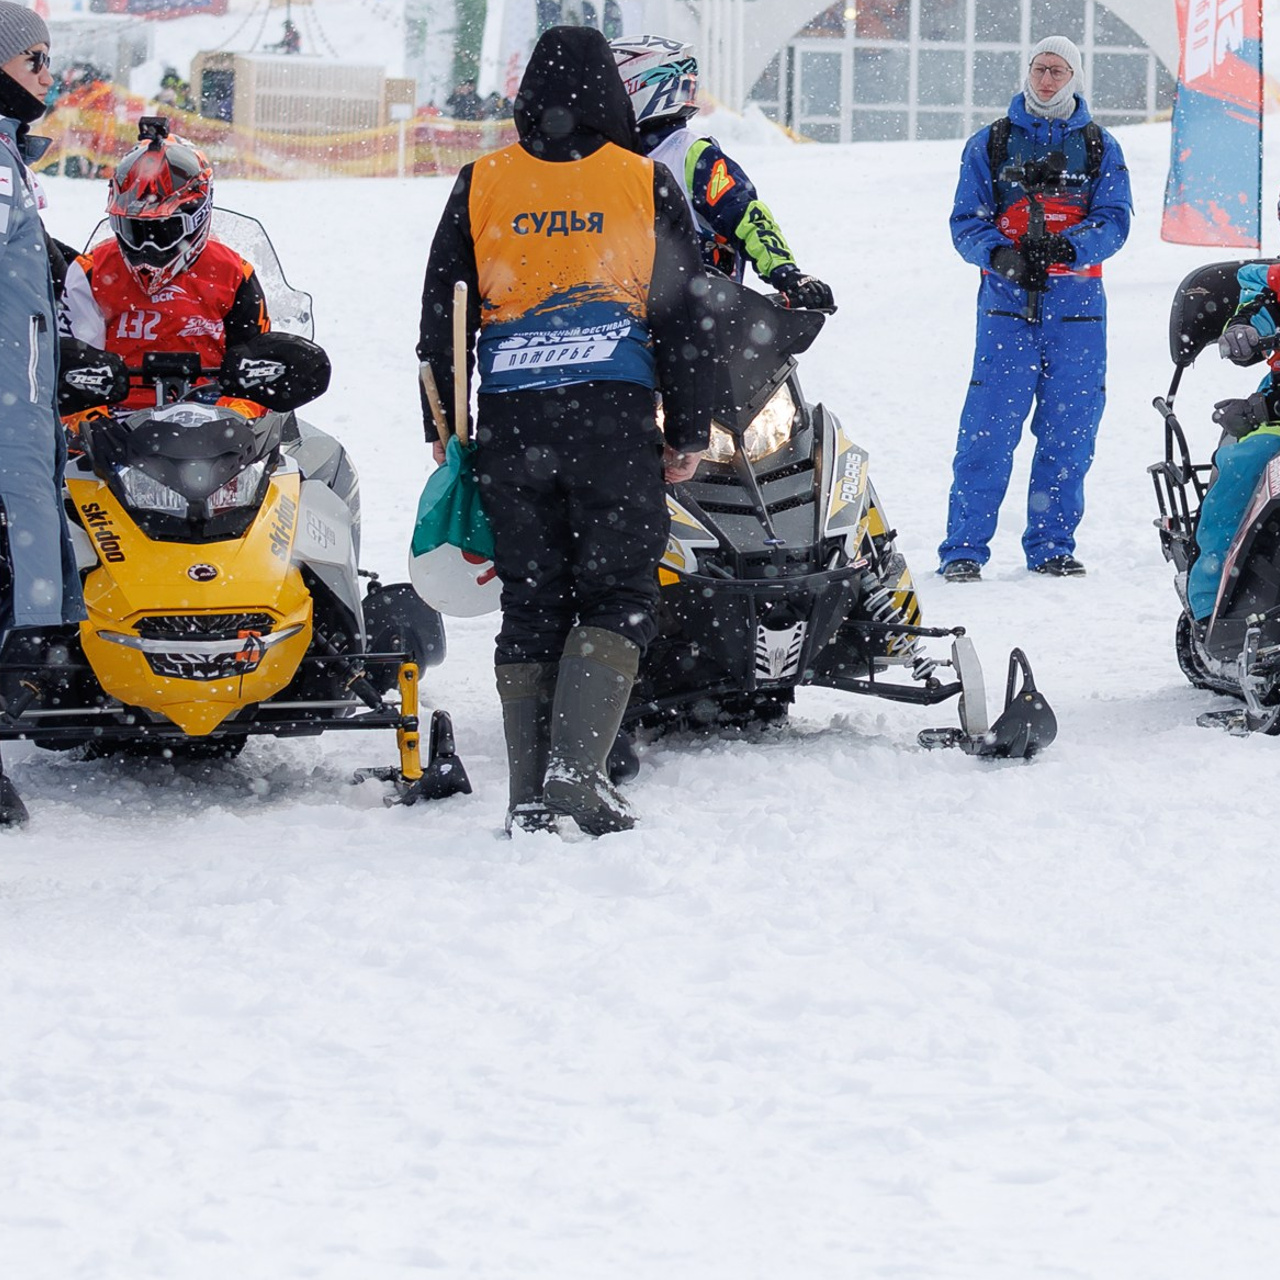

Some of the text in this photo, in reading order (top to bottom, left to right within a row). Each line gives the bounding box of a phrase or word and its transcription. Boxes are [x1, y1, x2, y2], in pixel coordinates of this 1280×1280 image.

[513, 210, 604, 237] СУДЬЯ
[582, 318, 631, 335] ФЕСТИВАЛЬ
[509, 345, 595, 367] ПОМОРЬЕ
[841, 452, 862, 504] POLARIS
[81, 502, 126, 563] ski-doo
[270, 493, 297, 562] ski-doo
